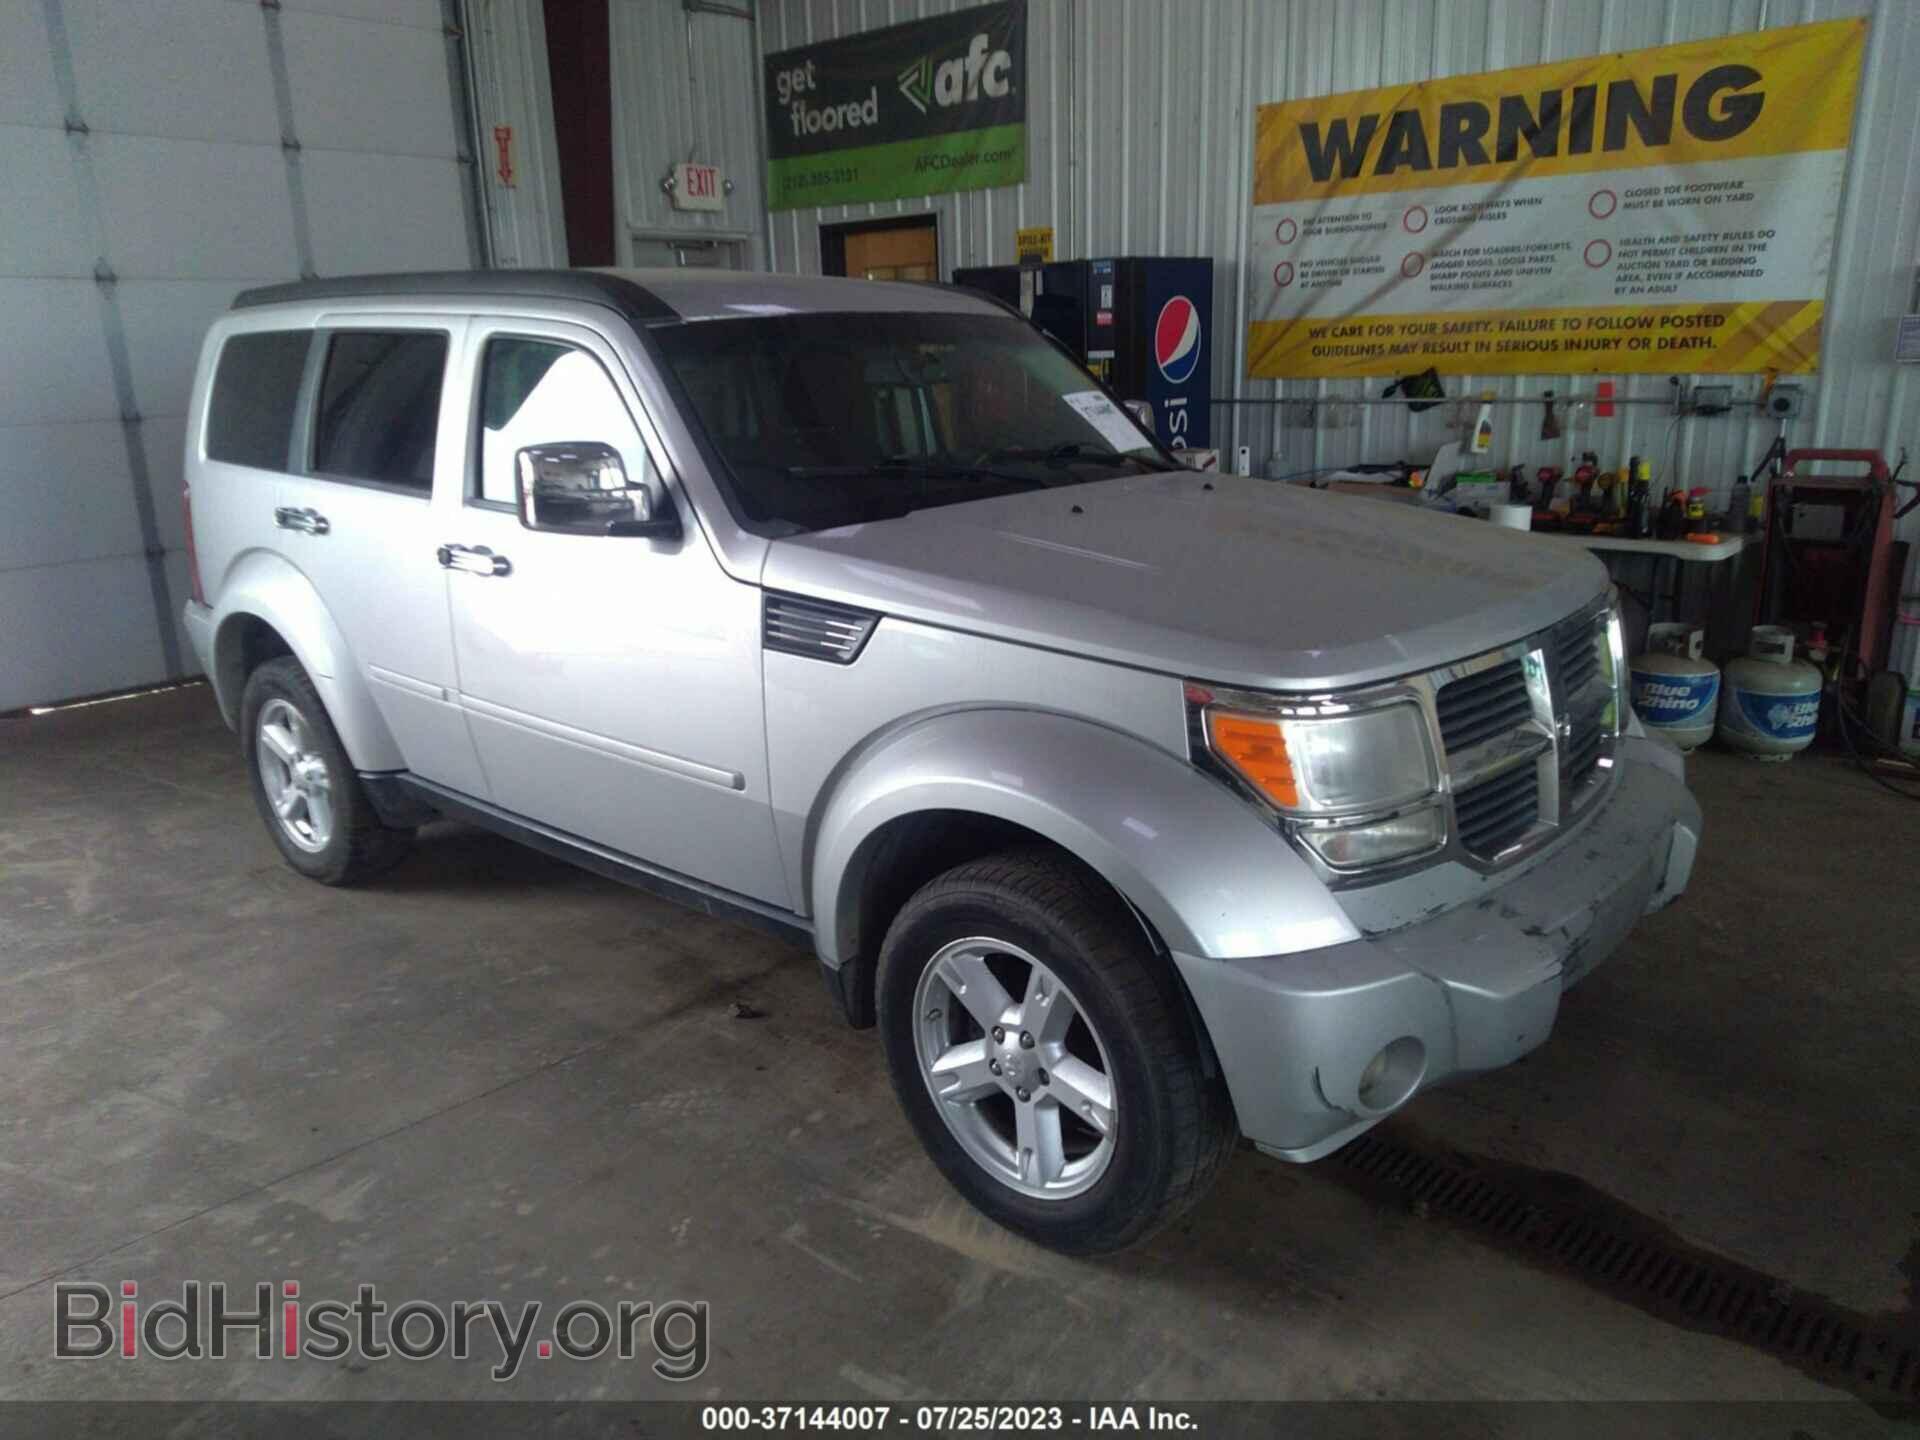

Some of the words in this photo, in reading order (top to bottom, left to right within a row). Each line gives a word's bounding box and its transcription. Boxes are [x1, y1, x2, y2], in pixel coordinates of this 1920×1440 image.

[935, 33, 1011, 107] afc
[776, 59, 816, 104] get
[791, 86, 879, 136] floored
[1300, 64, 1765, 182] WARNING
[686, 167, 716, 197] EXIT
[1624, 188, 1660, 198] CLOSED
[1664, 185, 1681, 195] TOE
[1684, 181, 1744, 193] FOOTWEAR
[1434, 205, 1459, 214] LOOK
[1514, 198, 1543, 206] WHEN
[1623, 200, 1650, 210] MUST
[1652, 199, 1664, 208] BE
[1667, 196, 1700, 207] WORN
[1704, 195, 1722, 204] ON
[1725, 192, 1755, 202] YARD
[1619, 236, 1655, 247] HEALTH
[1658, 234, 1681, 244] AND
[1684, 232, 1720, 242] SAFETY
[1723, 231, 1754, 240] RULES
[1757, 229, 1776, 238] DO
[1463, 248, 1481, 256] FOR
[1617, 248, 1638, 258] NOT
[1641, 247, 1675, 257] PERMIT
[1679, 244, 1728, 256] CHILDREN
[1731, 243, 1744, 252] IN
[1747, 242, 1767, 251] THE
[1617, 260, 1660, 270] AUCTION
[1664, 258, 1690, 268] YARD
[1693, 258, 1707, 267] OR
[1711, 256, 1757, 266] BIDDING
[1430, 272, 1458, 281] SHARP
[1461, 270, 1491, 279] POINTS
[1494, 268, 1513, 277] AND
[1516, 266, 1553, 275] UNEVEN
[1646, 272, 1671, 281] EVEN
[1674, 271, 1683, 280] IF
[1686, 269, 1764, 281] ACCOMPANIED
[1614, 286, 1627, 295] BY
[1629, 285, 1645, 294] AN
[1647, 284, 1678, 293] ADULT
[1309, 327, 1328, 338] WE
[1331, 325, 1363, 338] CARE
[1368, 323, 1394, 336] FOR
[1400, 322, 1440, 336] YOUR
[1500, 318, 1554, 332] FAILURE
[1561, 317, 1581, 330] TO
[1587, 315, 1655, 330] FOLLOW
[1660, 314, 1726, 328] POSTED
[1312, 343, 1385, 358] GUIDELINES
[1389, 342, 1418, 356] MAY
[1422, 340, 1470, 354] RESULT
[1475, 340, 1490, 353] IN
[1496, 338, 1559, 353] SERIOUS
[1564, 337, 1621, 351] INJURY
[1628, 336, 1650, 350] OR
[1657, 336, 1717, 350] DEATH.
